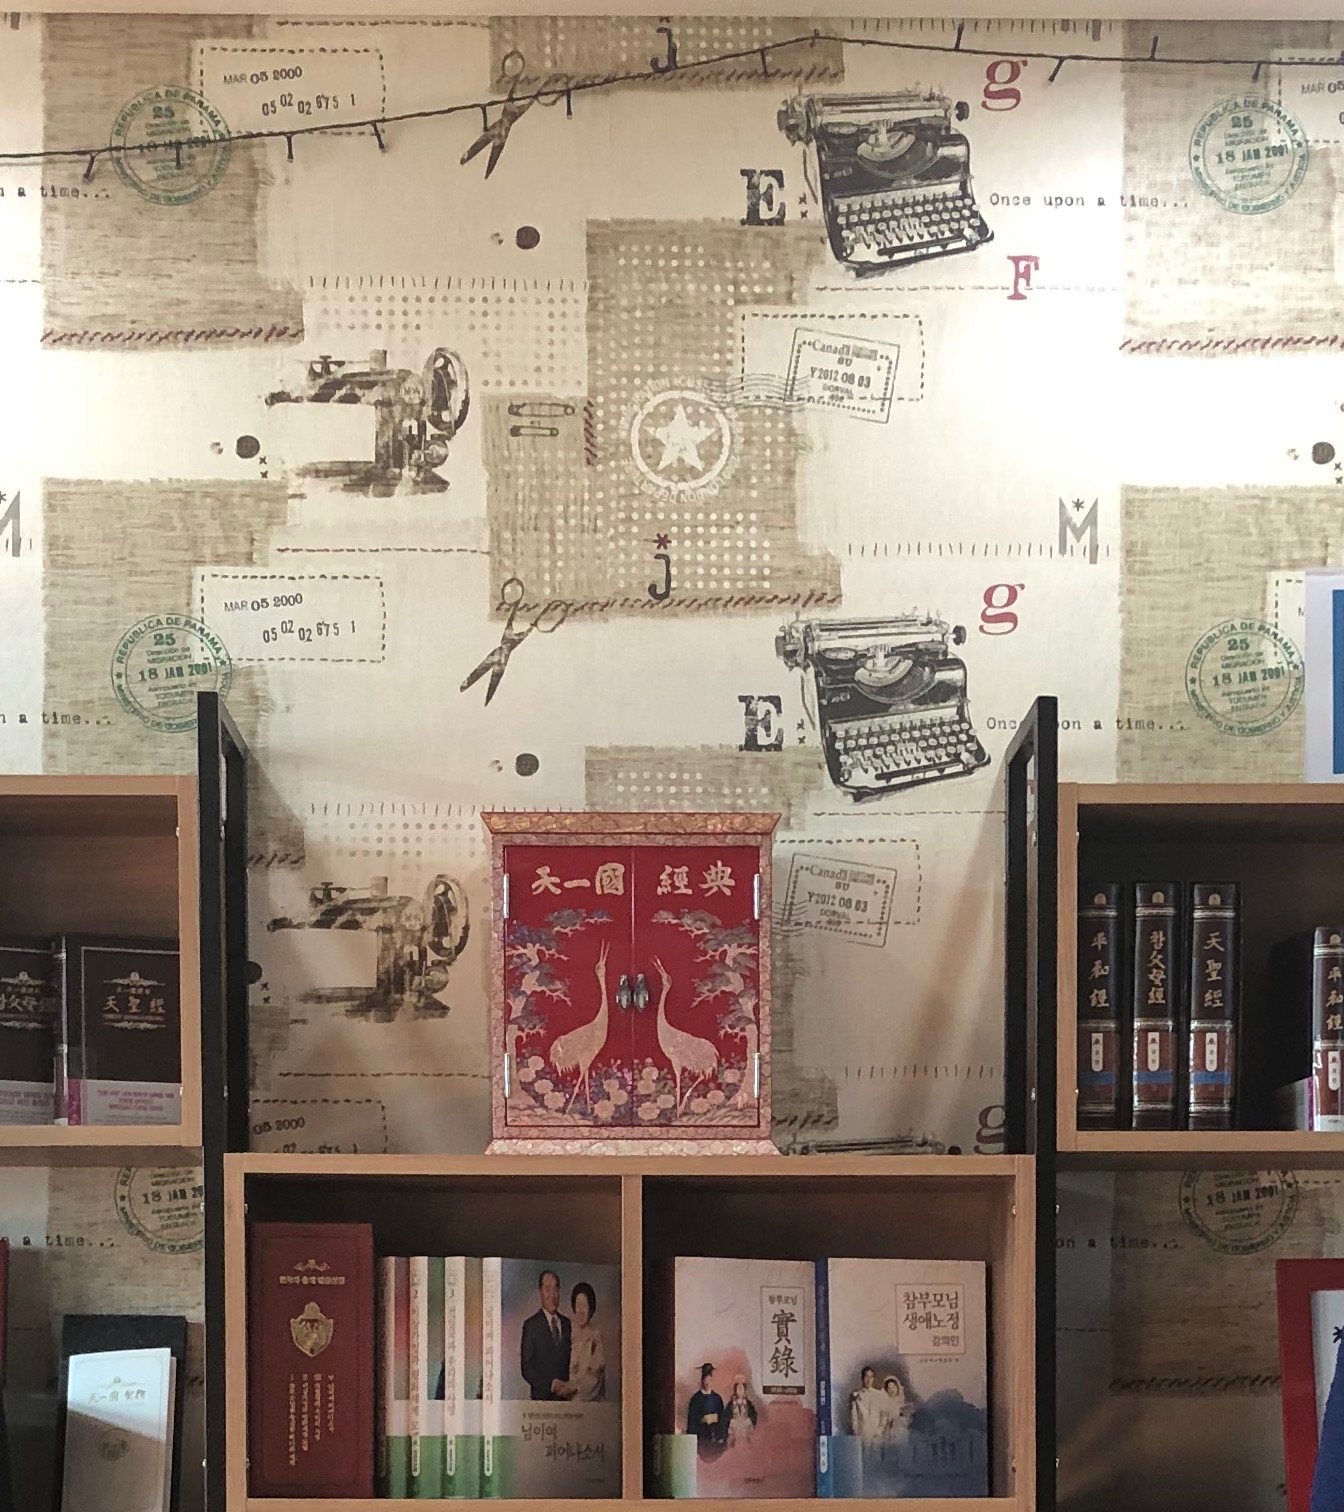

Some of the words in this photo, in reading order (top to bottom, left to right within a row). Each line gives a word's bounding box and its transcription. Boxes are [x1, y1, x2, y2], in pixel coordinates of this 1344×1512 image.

[980, 59, 1029, 112] g
[739, 168, 787, 228] E
[988, 191, 1033, 208] Once
[1041, 194, 1087, 212] upon
[1006, 254, 1040, 301] F
[223, 601, 249, 613] MAR
[250, 597, 270, 612] 05
[272, 592, 304, 608] 2000
[977, 582, 1025, 636] g
[152, 632, 177, 647] 25
[262, 627, 279, 644] 05
[280, 619, 295, 634] 02
[297, 627, 313, 643] 02
[1227, 637, 1250, 652] 25
[138, 668, 160, 683] 18
[1212, 671, 1233, 688] 18
[18, 711, 29, 724] a
[737, 694, 784, 752] E
[531, 861, 626, 897] 天一國
[657, 860, 736, 897] 經典
[902, 1289, 960, 1312] 참부모님
[902, 1311, 961, 1332] 생애노정
